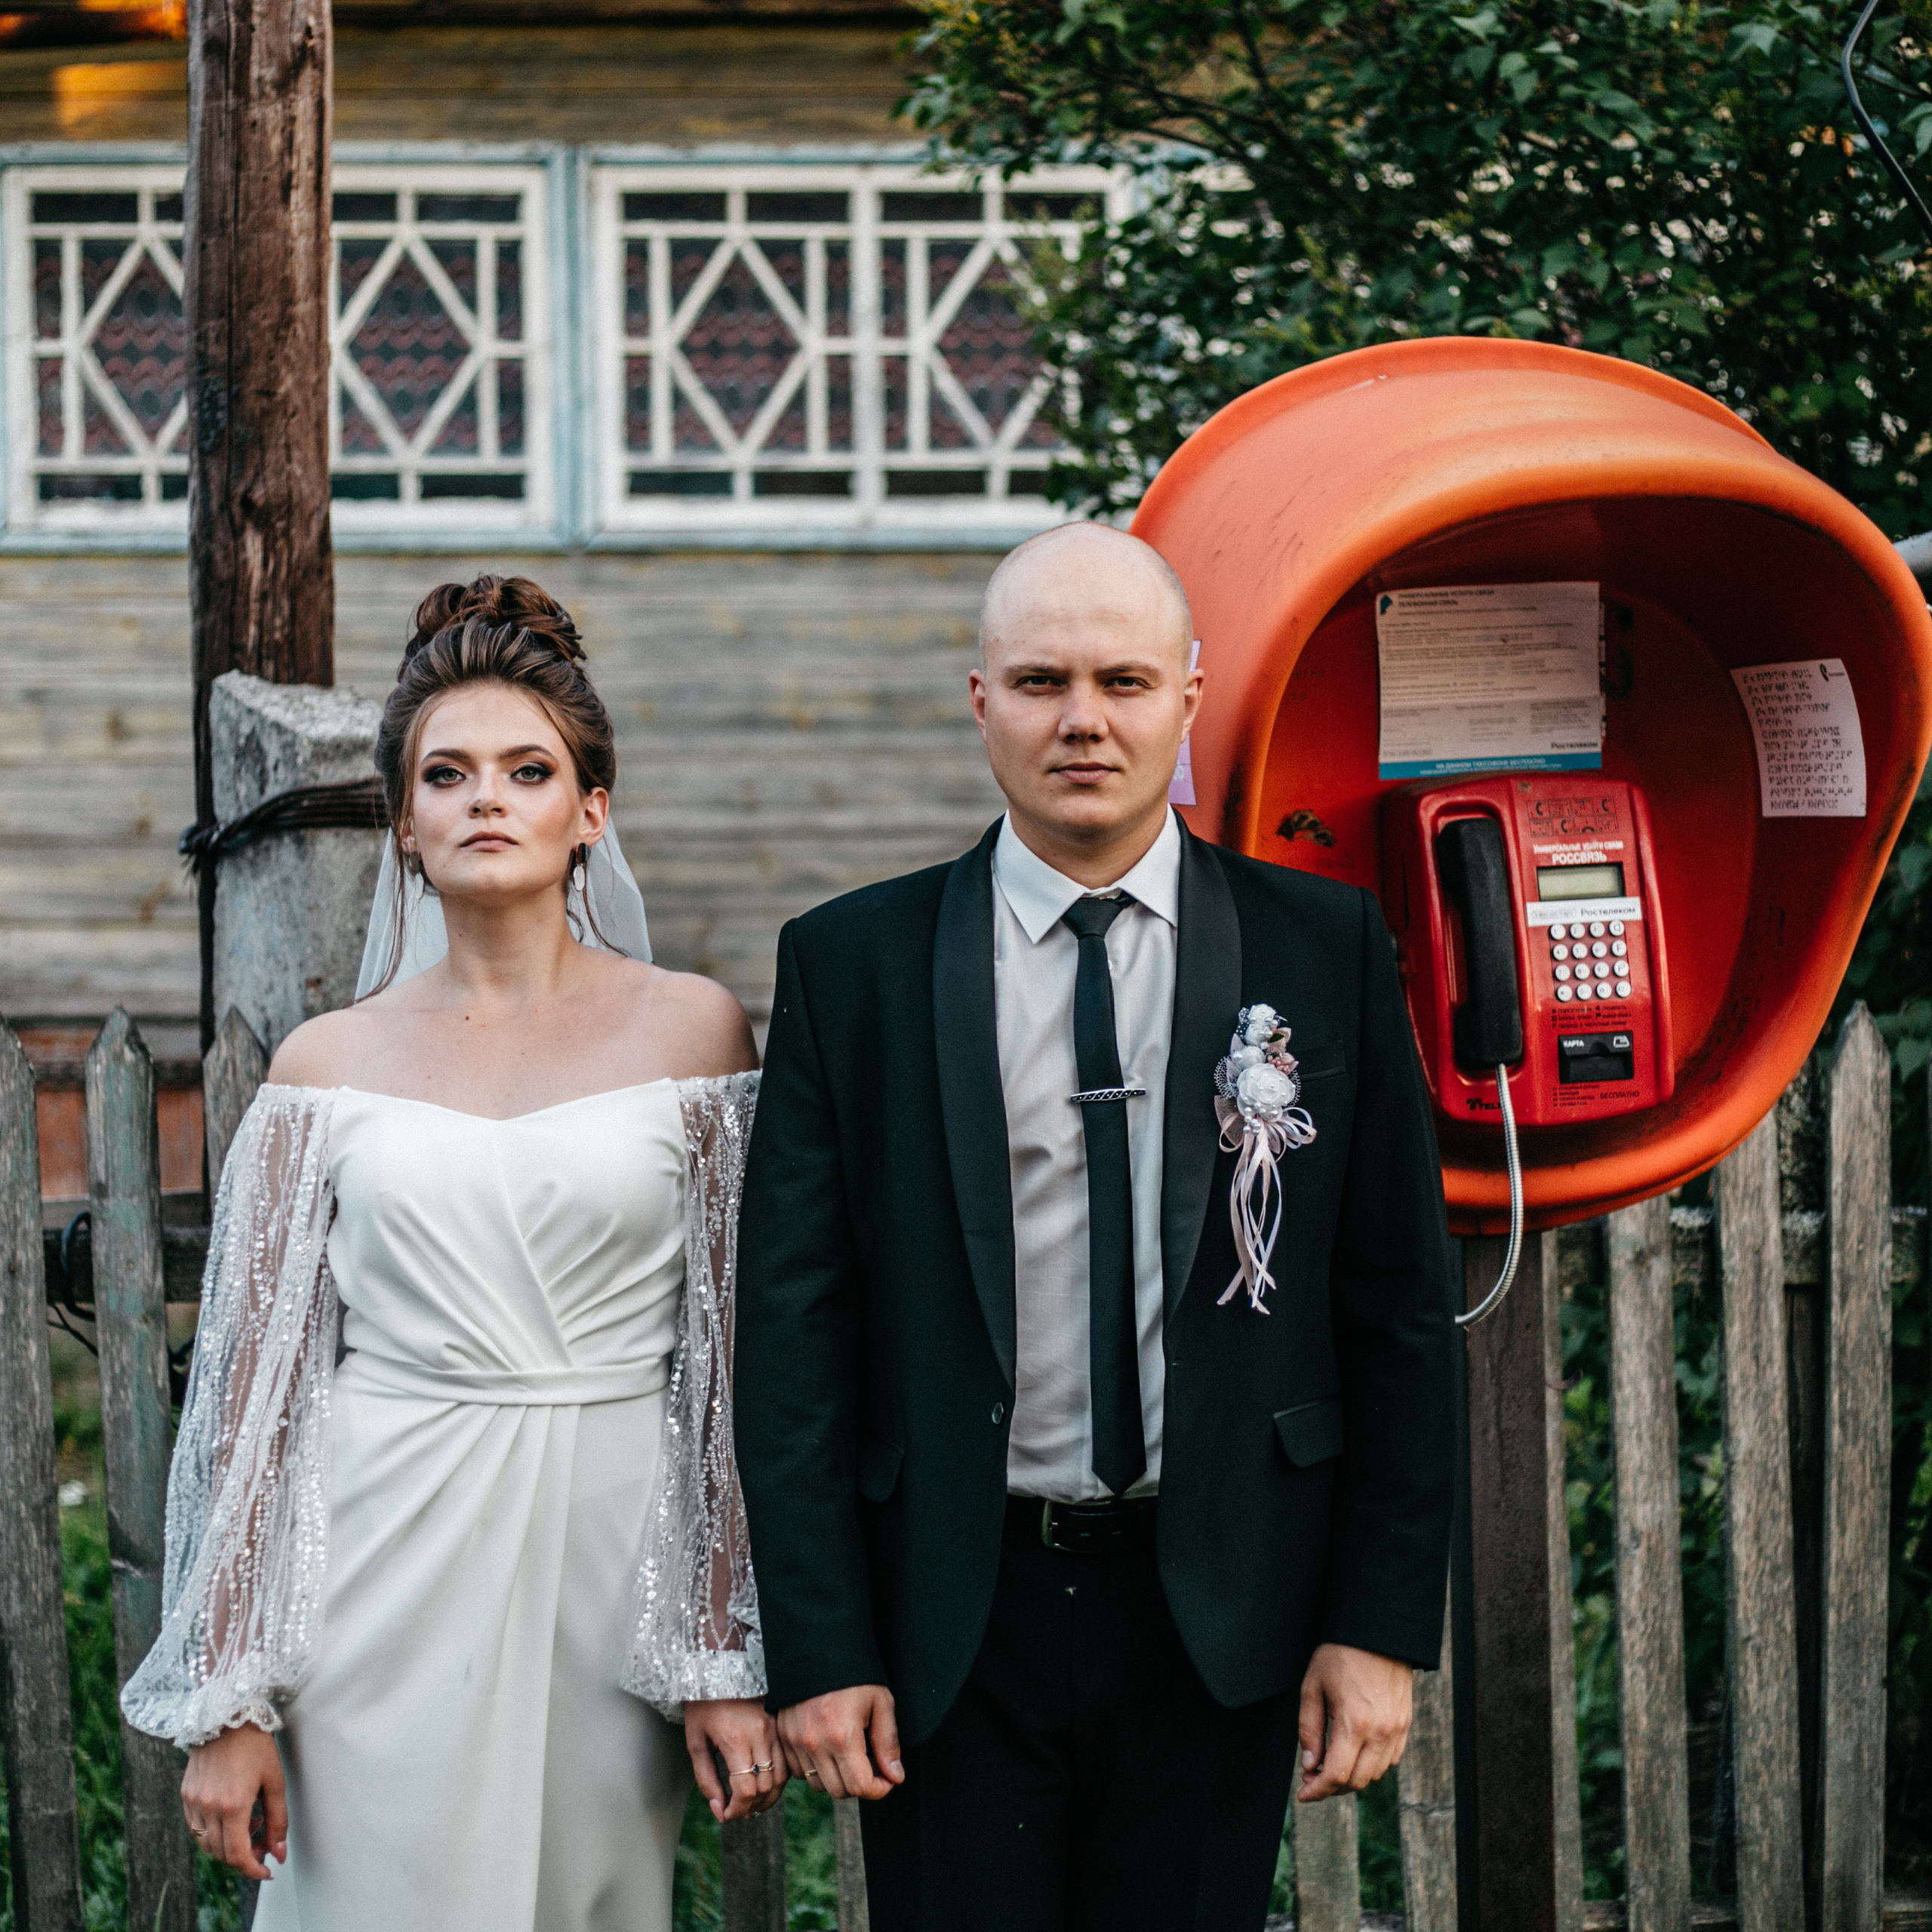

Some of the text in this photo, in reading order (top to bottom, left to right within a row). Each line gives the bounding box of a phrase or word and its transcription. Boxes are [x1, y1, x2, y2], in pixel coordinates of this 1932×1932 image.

[1551, 741, 1598, 749] Ростелеком
[1552, 851, 1607, 865] РОССВЯЗЬ
[1580, 907, 1635, 916] Ростелеком
[1563, 1039, 1585, 1048] КАРТА
[1600, 1091, 1640, 1100] БЕСПЛАТНО
